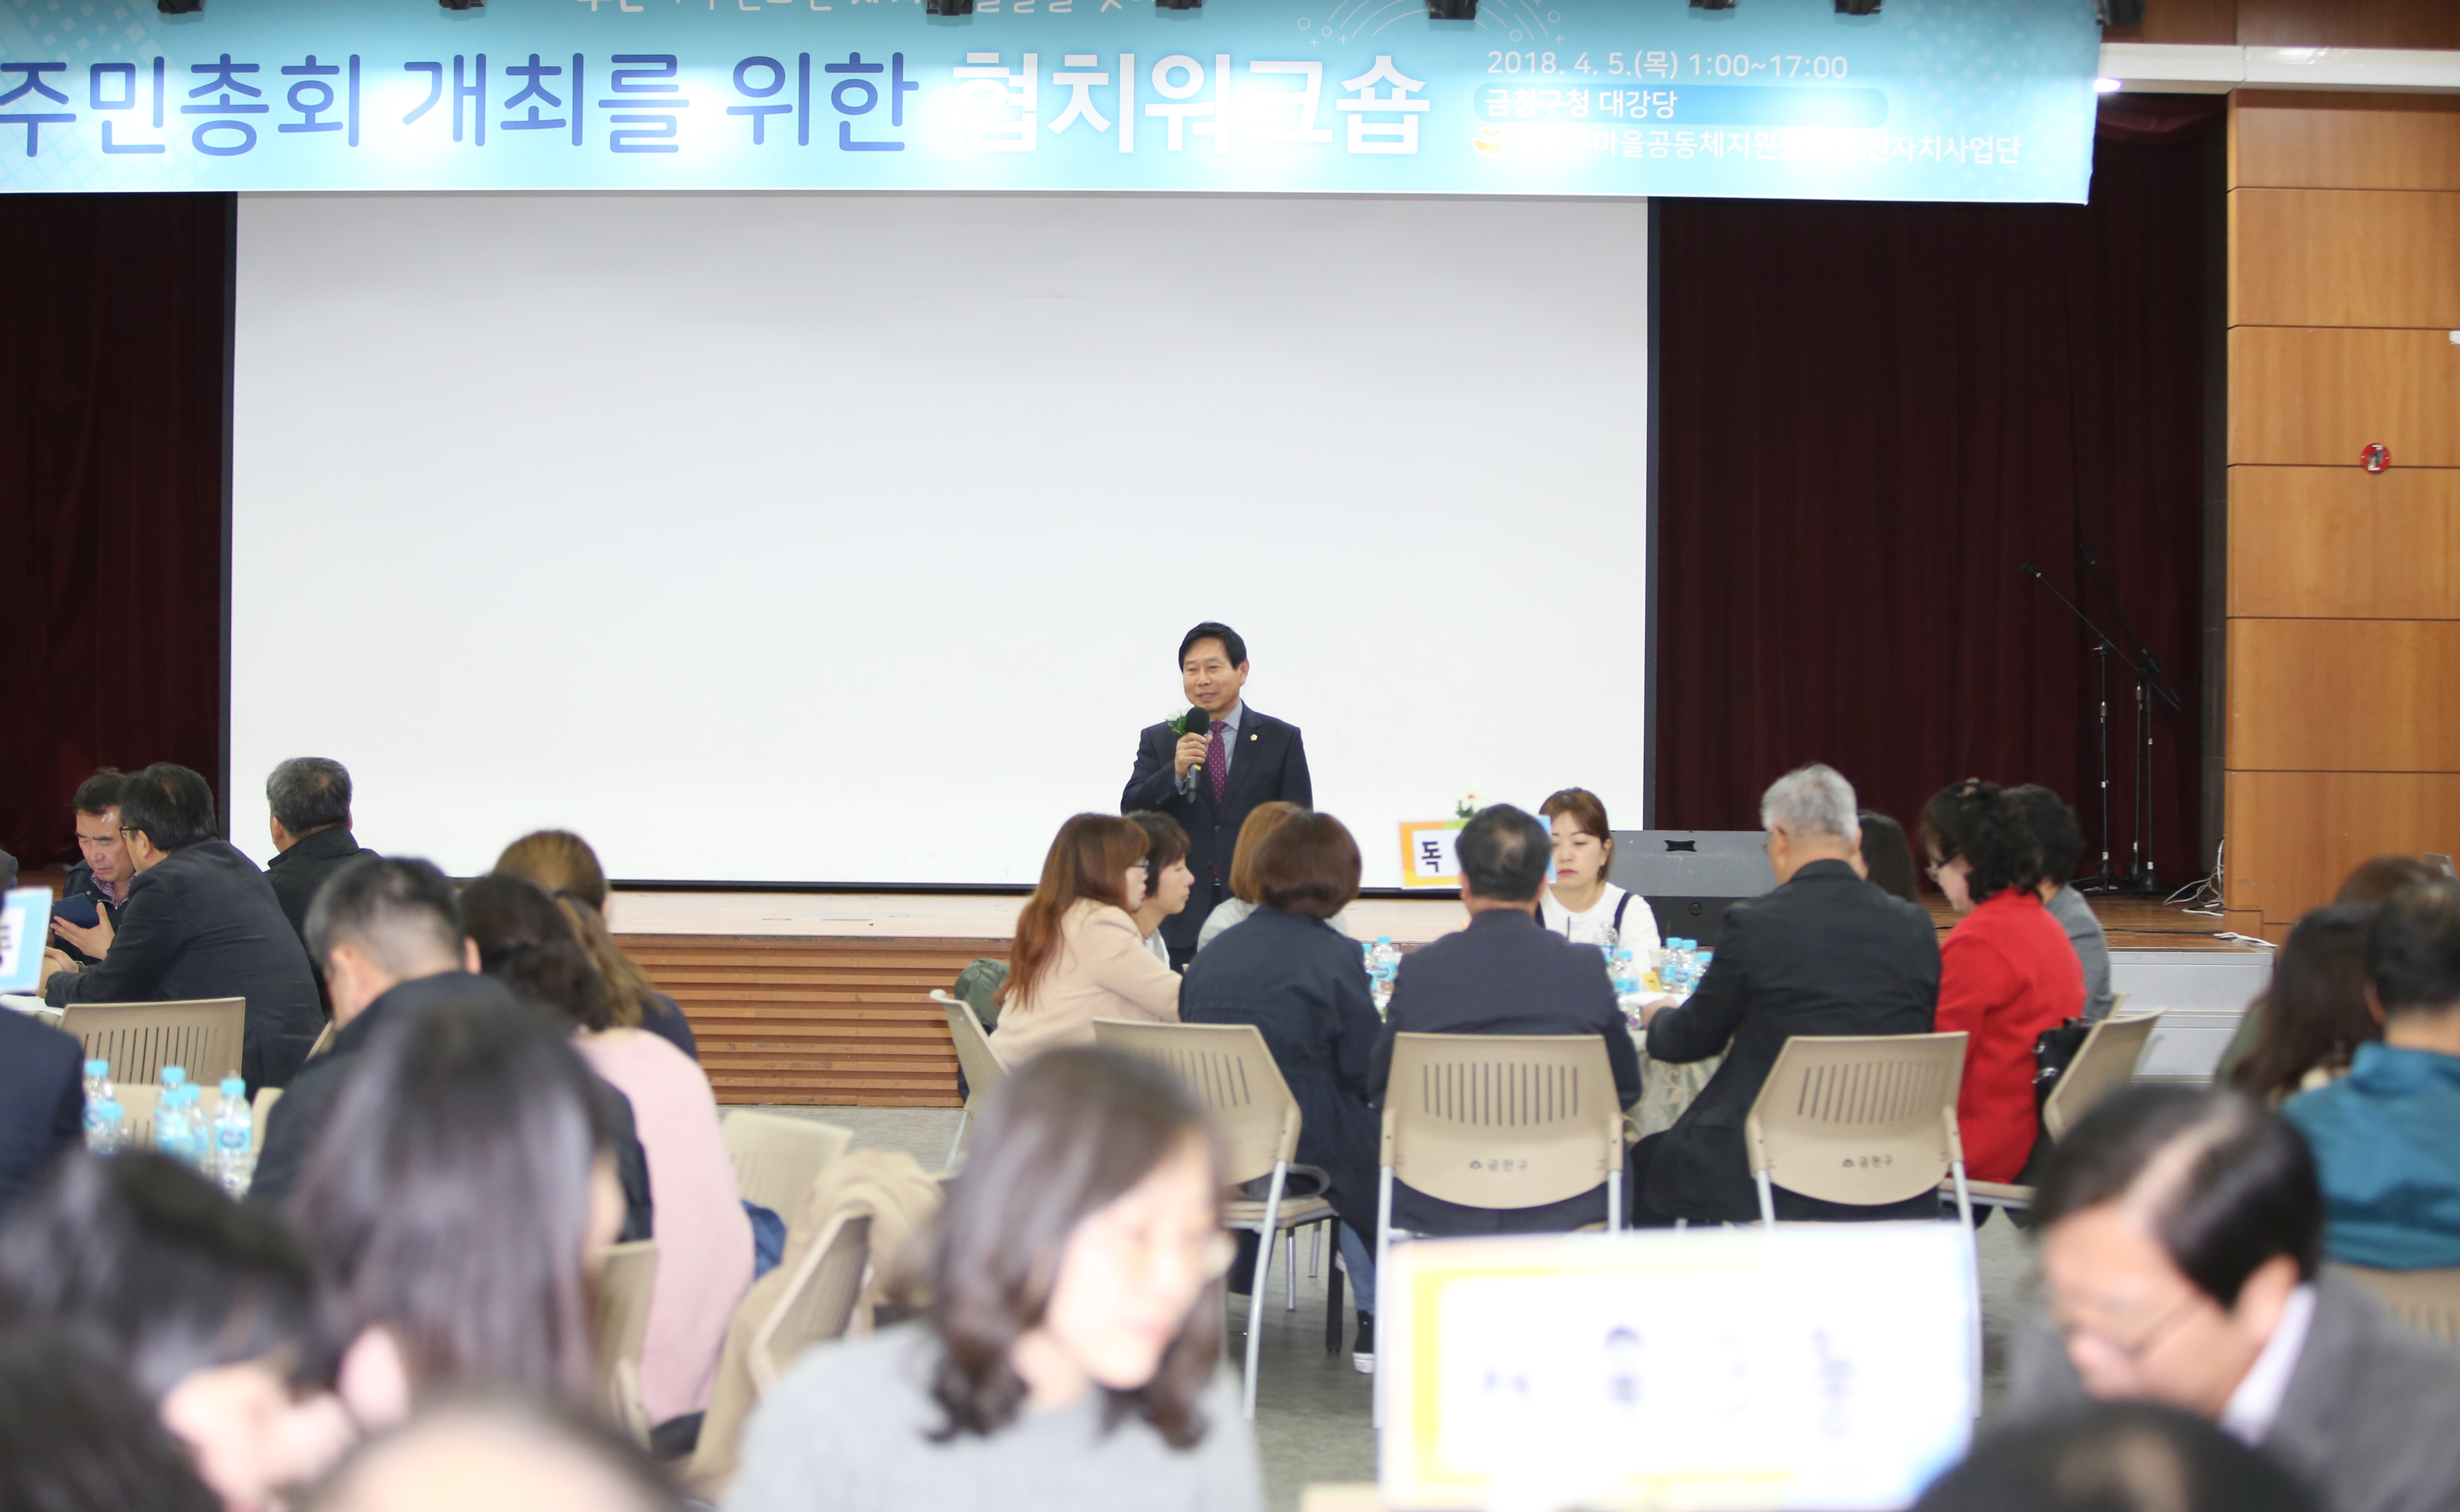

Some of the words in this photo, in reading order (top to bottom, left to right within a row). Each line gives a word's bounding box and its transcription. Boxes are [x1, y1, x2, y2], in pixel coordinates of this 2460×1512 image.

[1487, 51, 1565, 75] 2018.
[1573, 52, 1598, 76] 4.
[1608, 51, 1678, 79] 5.(목)
[1689, 54, 1848, 79] 1:00~17:00
[0, 54, 360, 157] 주민총회
[403, 53, 690, 153] 개최를
[726, 52, 920, 152] 위한
[953, 53, 1431, 154] 협치워크숍
[1599, 90, 1678, 120] 대강당
